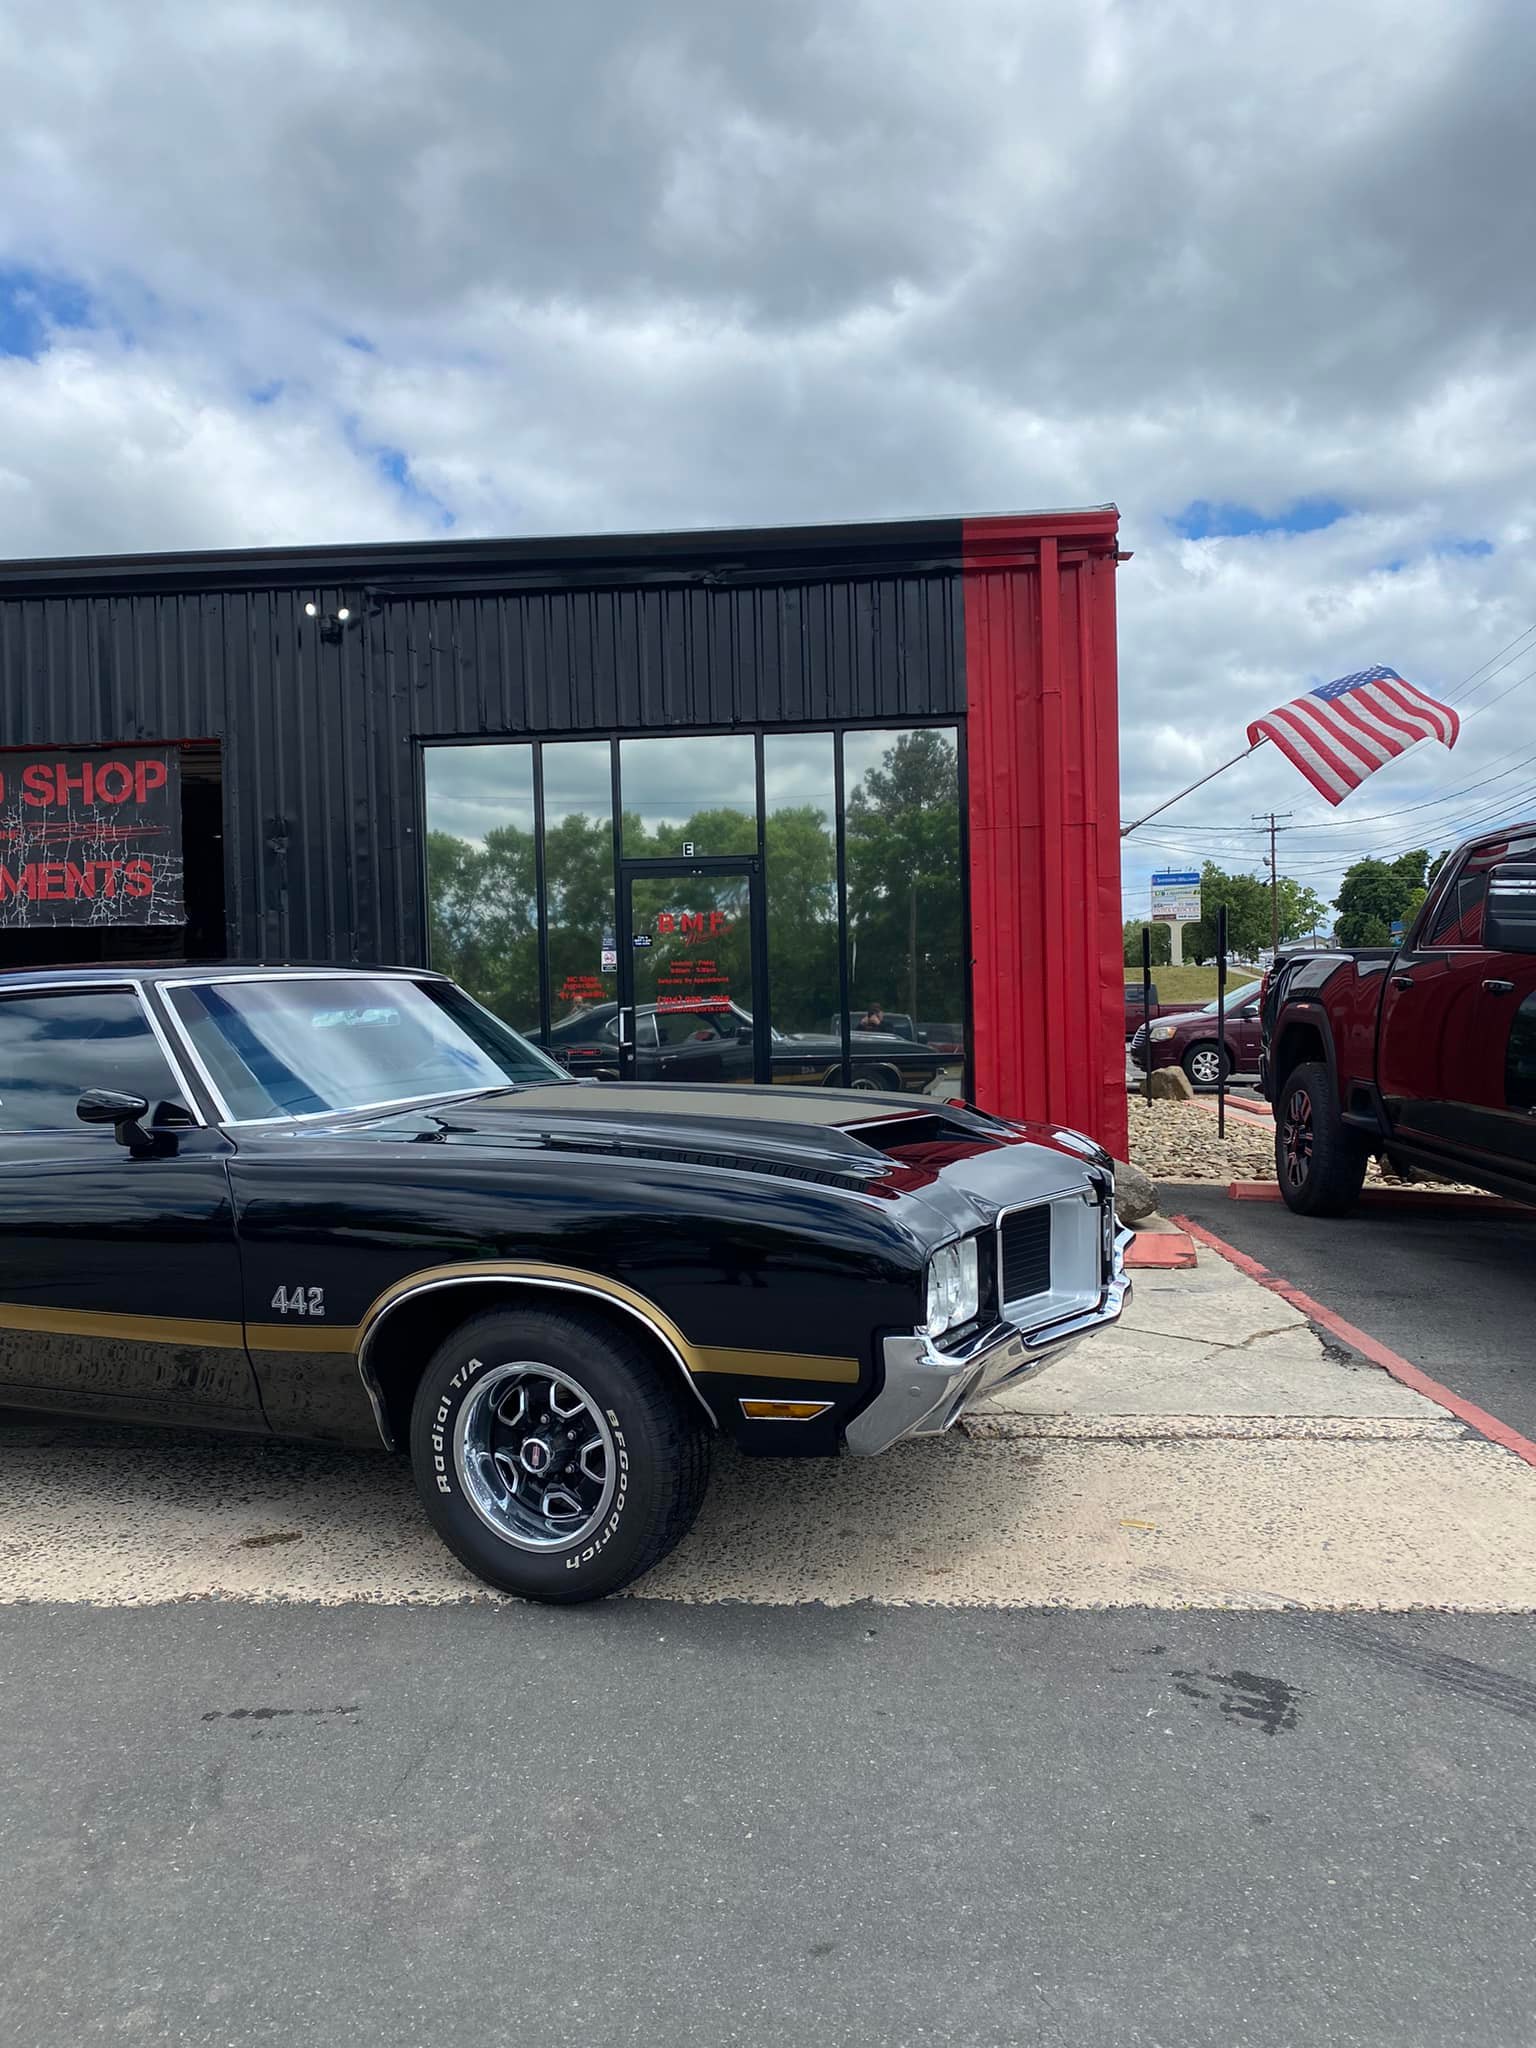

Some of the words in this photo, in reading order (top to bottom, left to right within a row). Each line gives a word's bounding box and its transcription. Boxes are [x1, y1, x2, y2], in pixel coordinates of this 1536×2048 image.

[22, 760, 167, 806] SHOP
[684, 843, 693, 856] E
[0, 860, 155, 900] MENTS
[658, 912, 724, 935] BMF
[271, 1285, 326, 1316] 442
[431, 1395, 452, 1494] Radial
[449, 1358, 484, 1389] T/A
[565, 1409, 630, 1570] BFGoodrich
